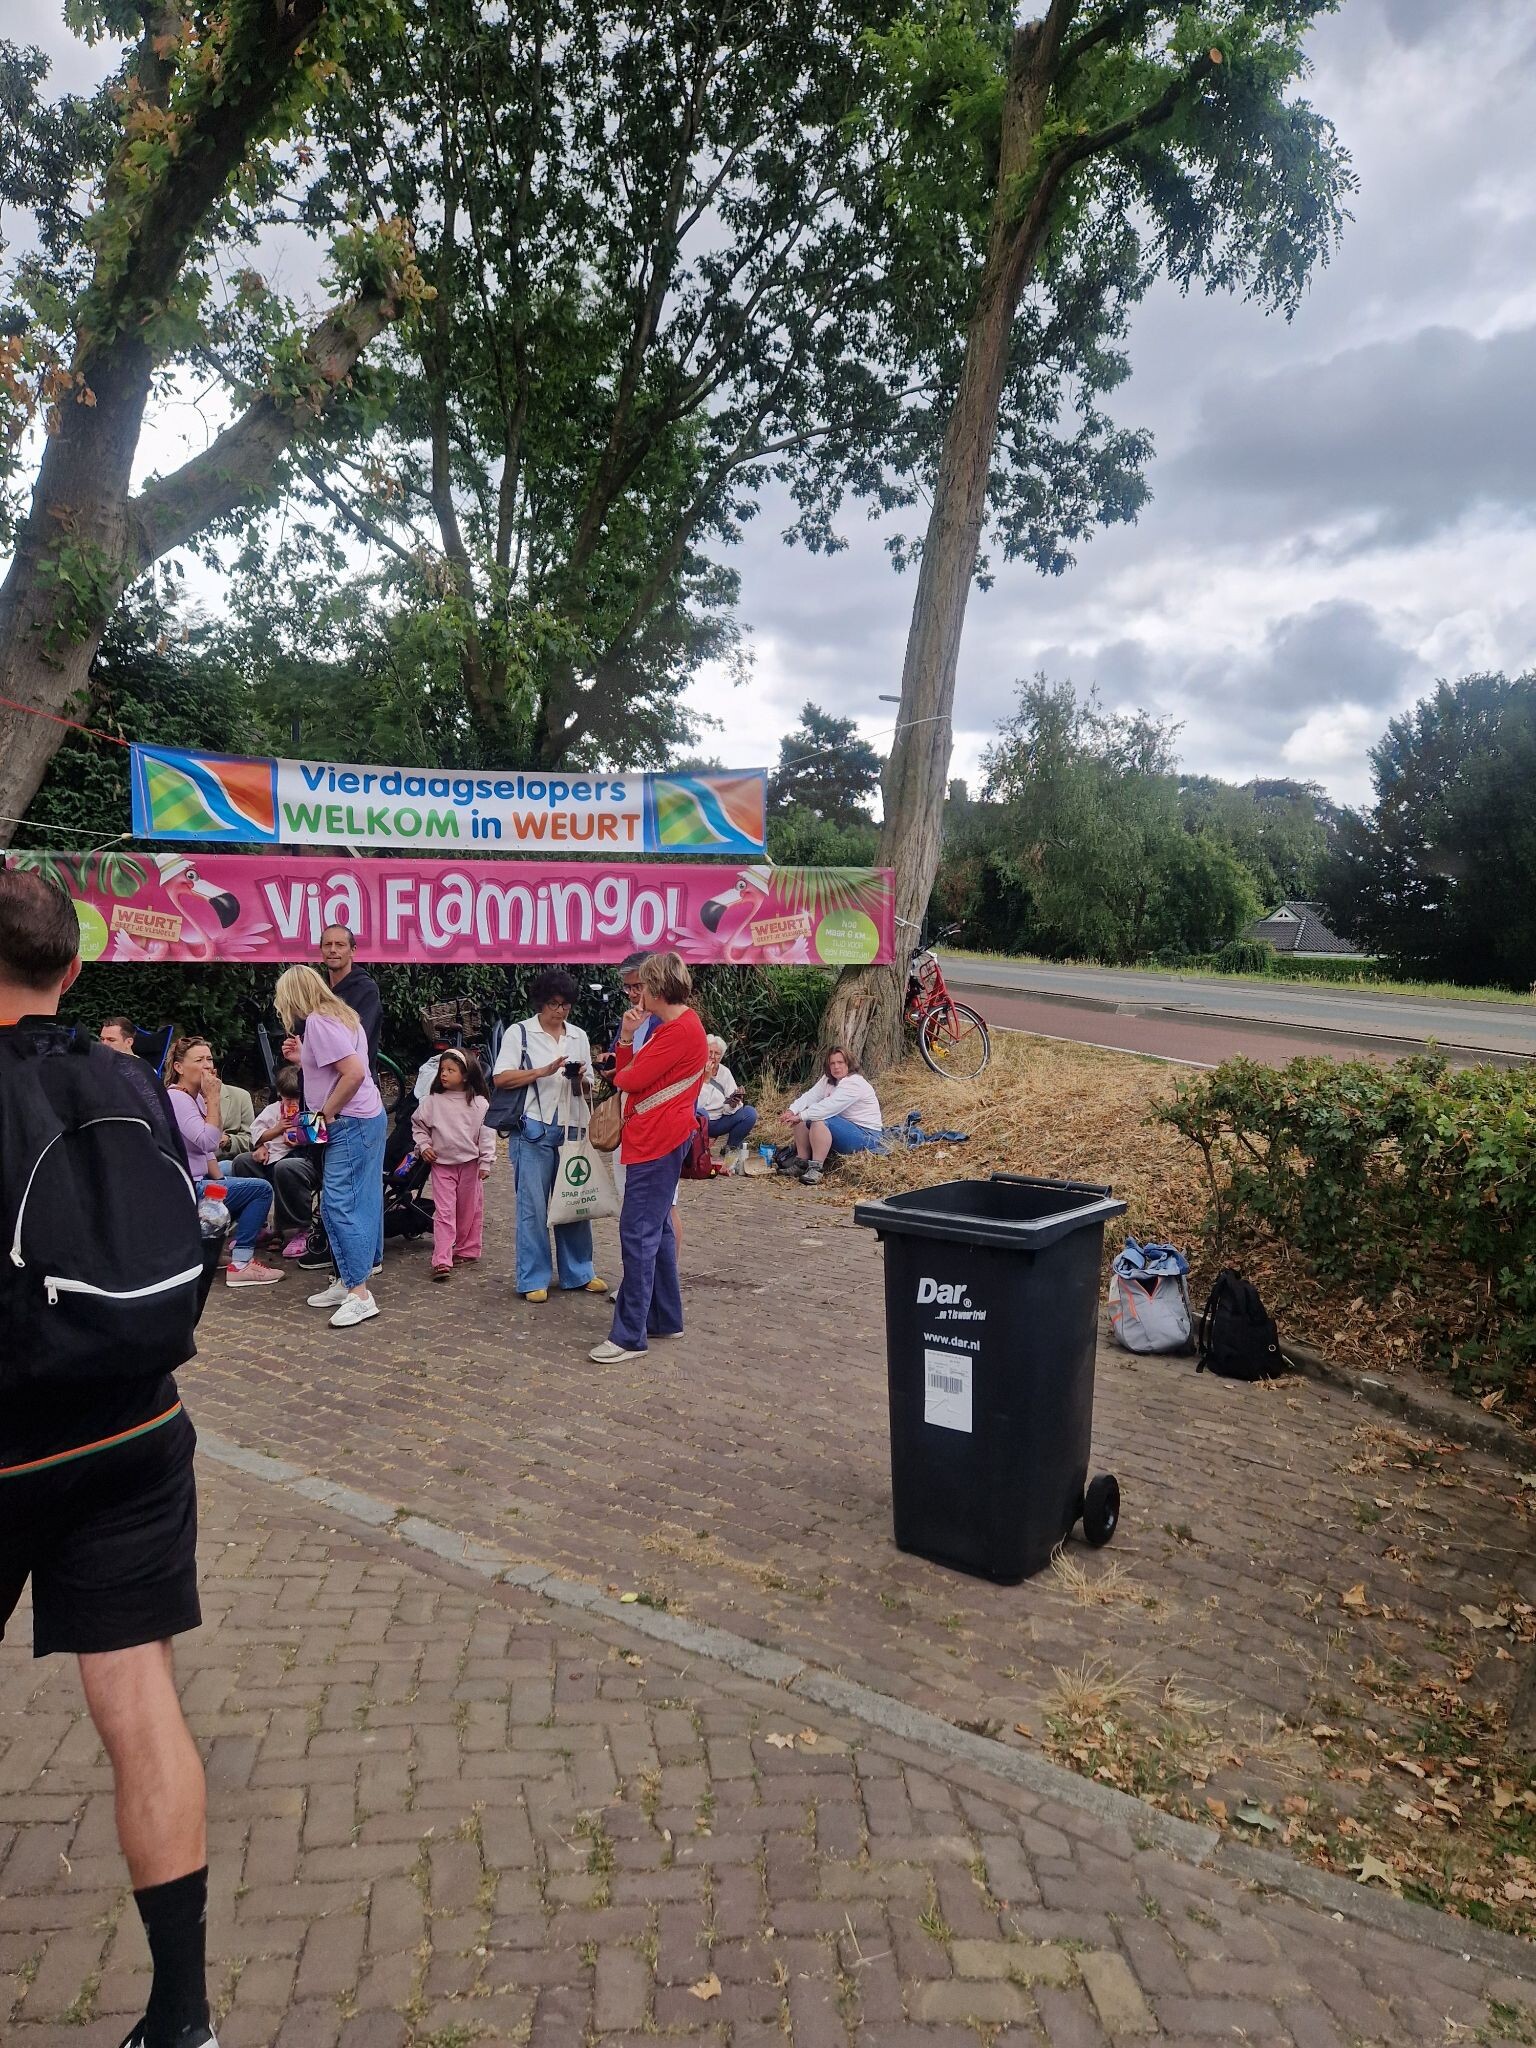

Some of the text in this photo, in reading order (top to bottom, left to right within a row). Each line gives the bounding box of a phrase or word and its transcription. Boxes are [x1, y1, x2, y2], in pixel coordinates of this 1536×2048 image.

[300, 765, 627, 808] Vierdaagselopers
[283, 803, 641, 841] WELKOM in WEURT
[117, 909, 178, 930] WEURT
[263, 873, 681, 948] Via Flamingo!
[754, 918, 804, 936] WEURT
[581, 1195, 597, 1204] DAG
[923, 1332, 981, 1351] www.dar.nl
